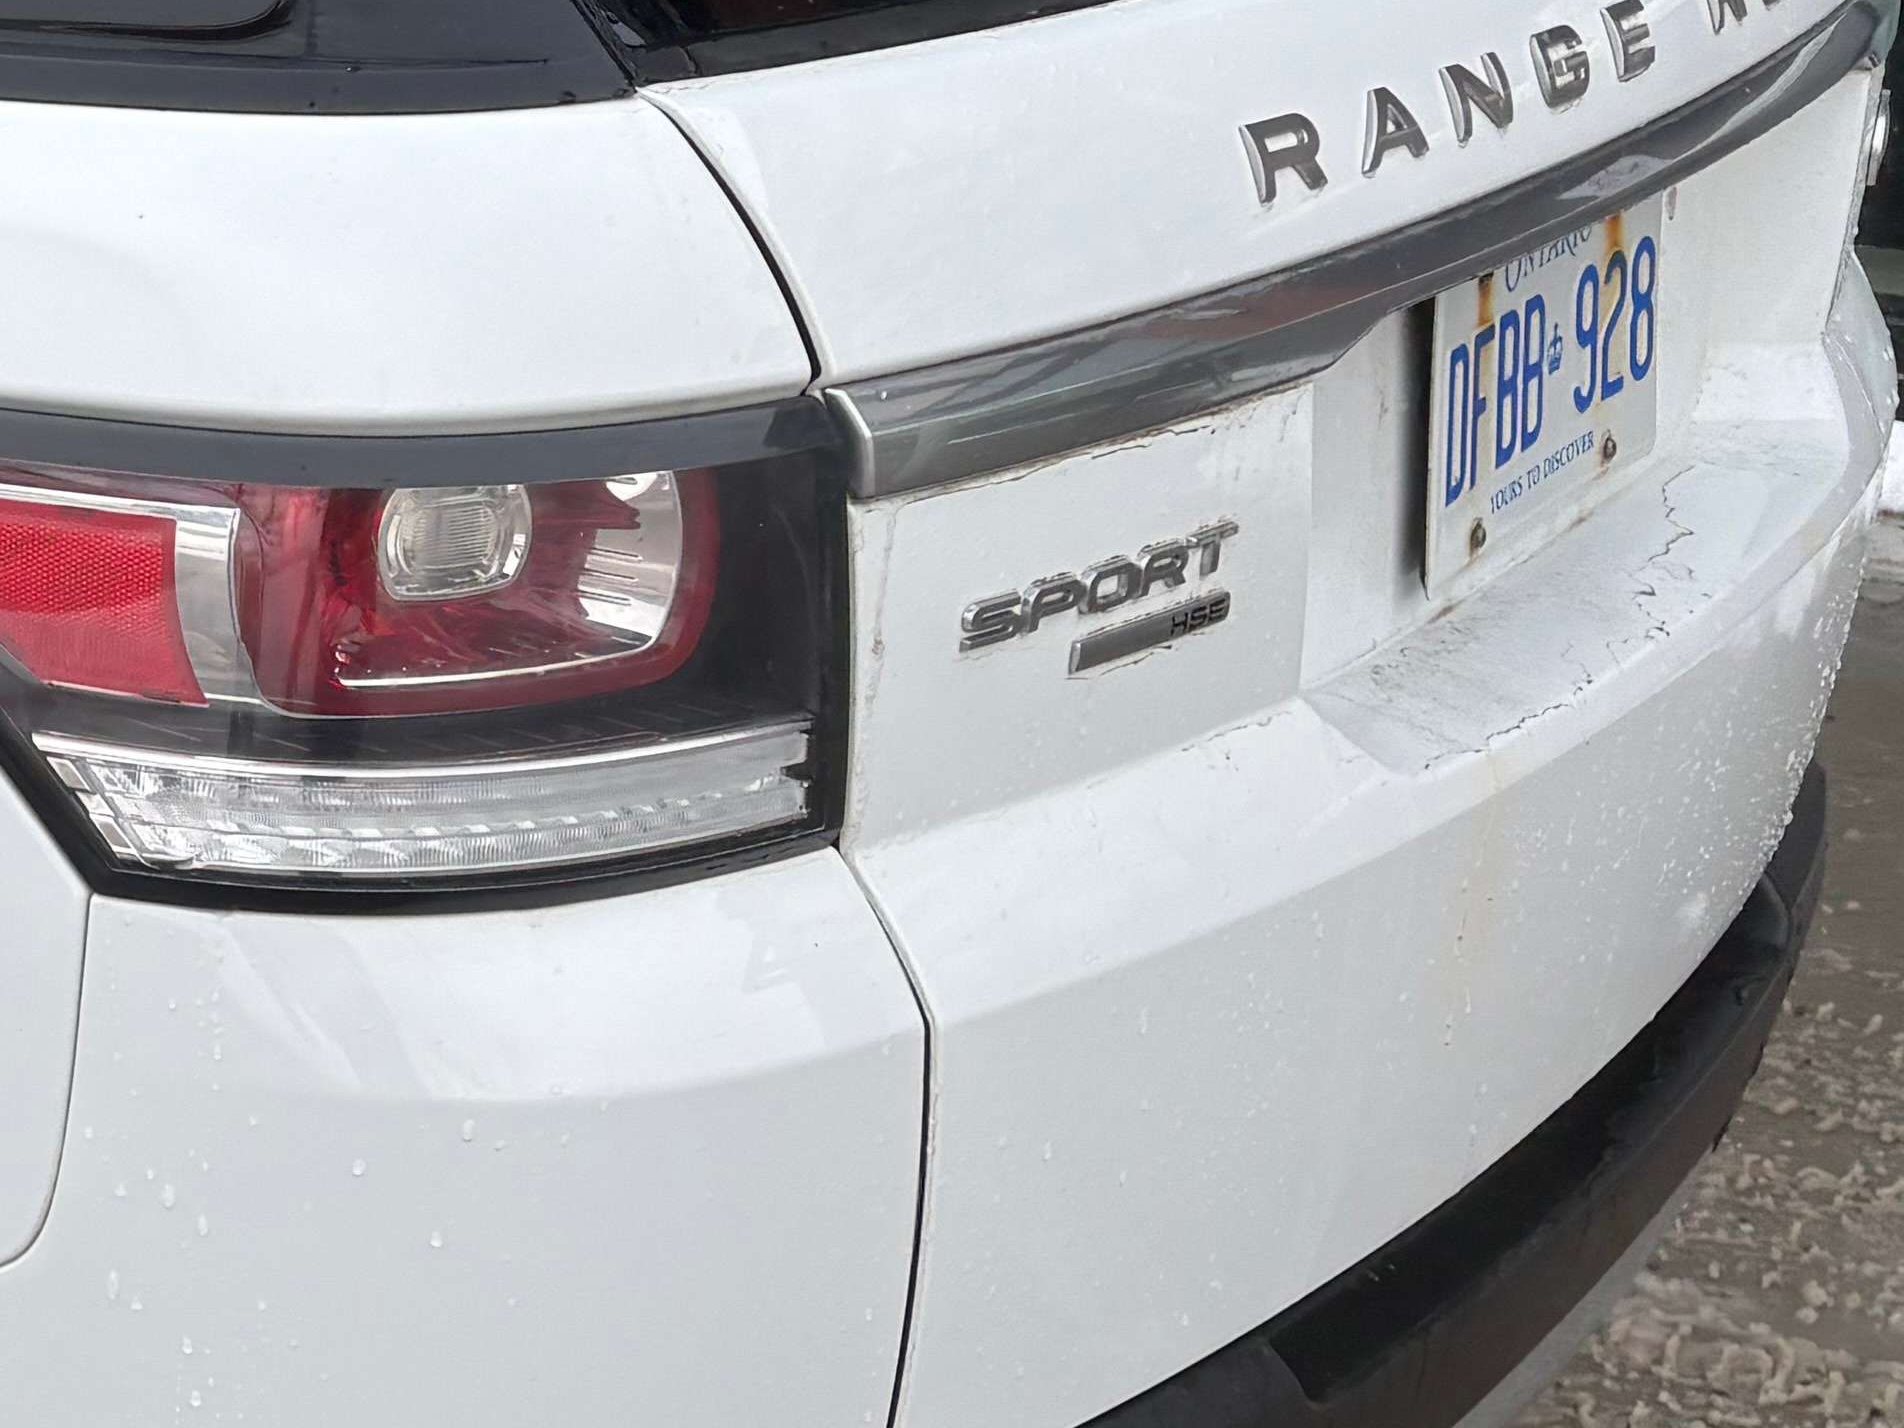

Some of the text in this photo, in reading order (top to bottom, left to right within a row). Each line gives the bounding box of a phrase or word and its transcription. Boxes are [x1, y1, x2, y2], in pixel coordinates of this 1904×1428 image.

[1445, 235, 1657, 509] DFBB 928
[1526, 464, 1541, 490] TO
[1543, 430, 1595, 479] DISCOVER
[959, 517, 1240, 654] SPORT
[1170, 598, 1227, 637] HSE
